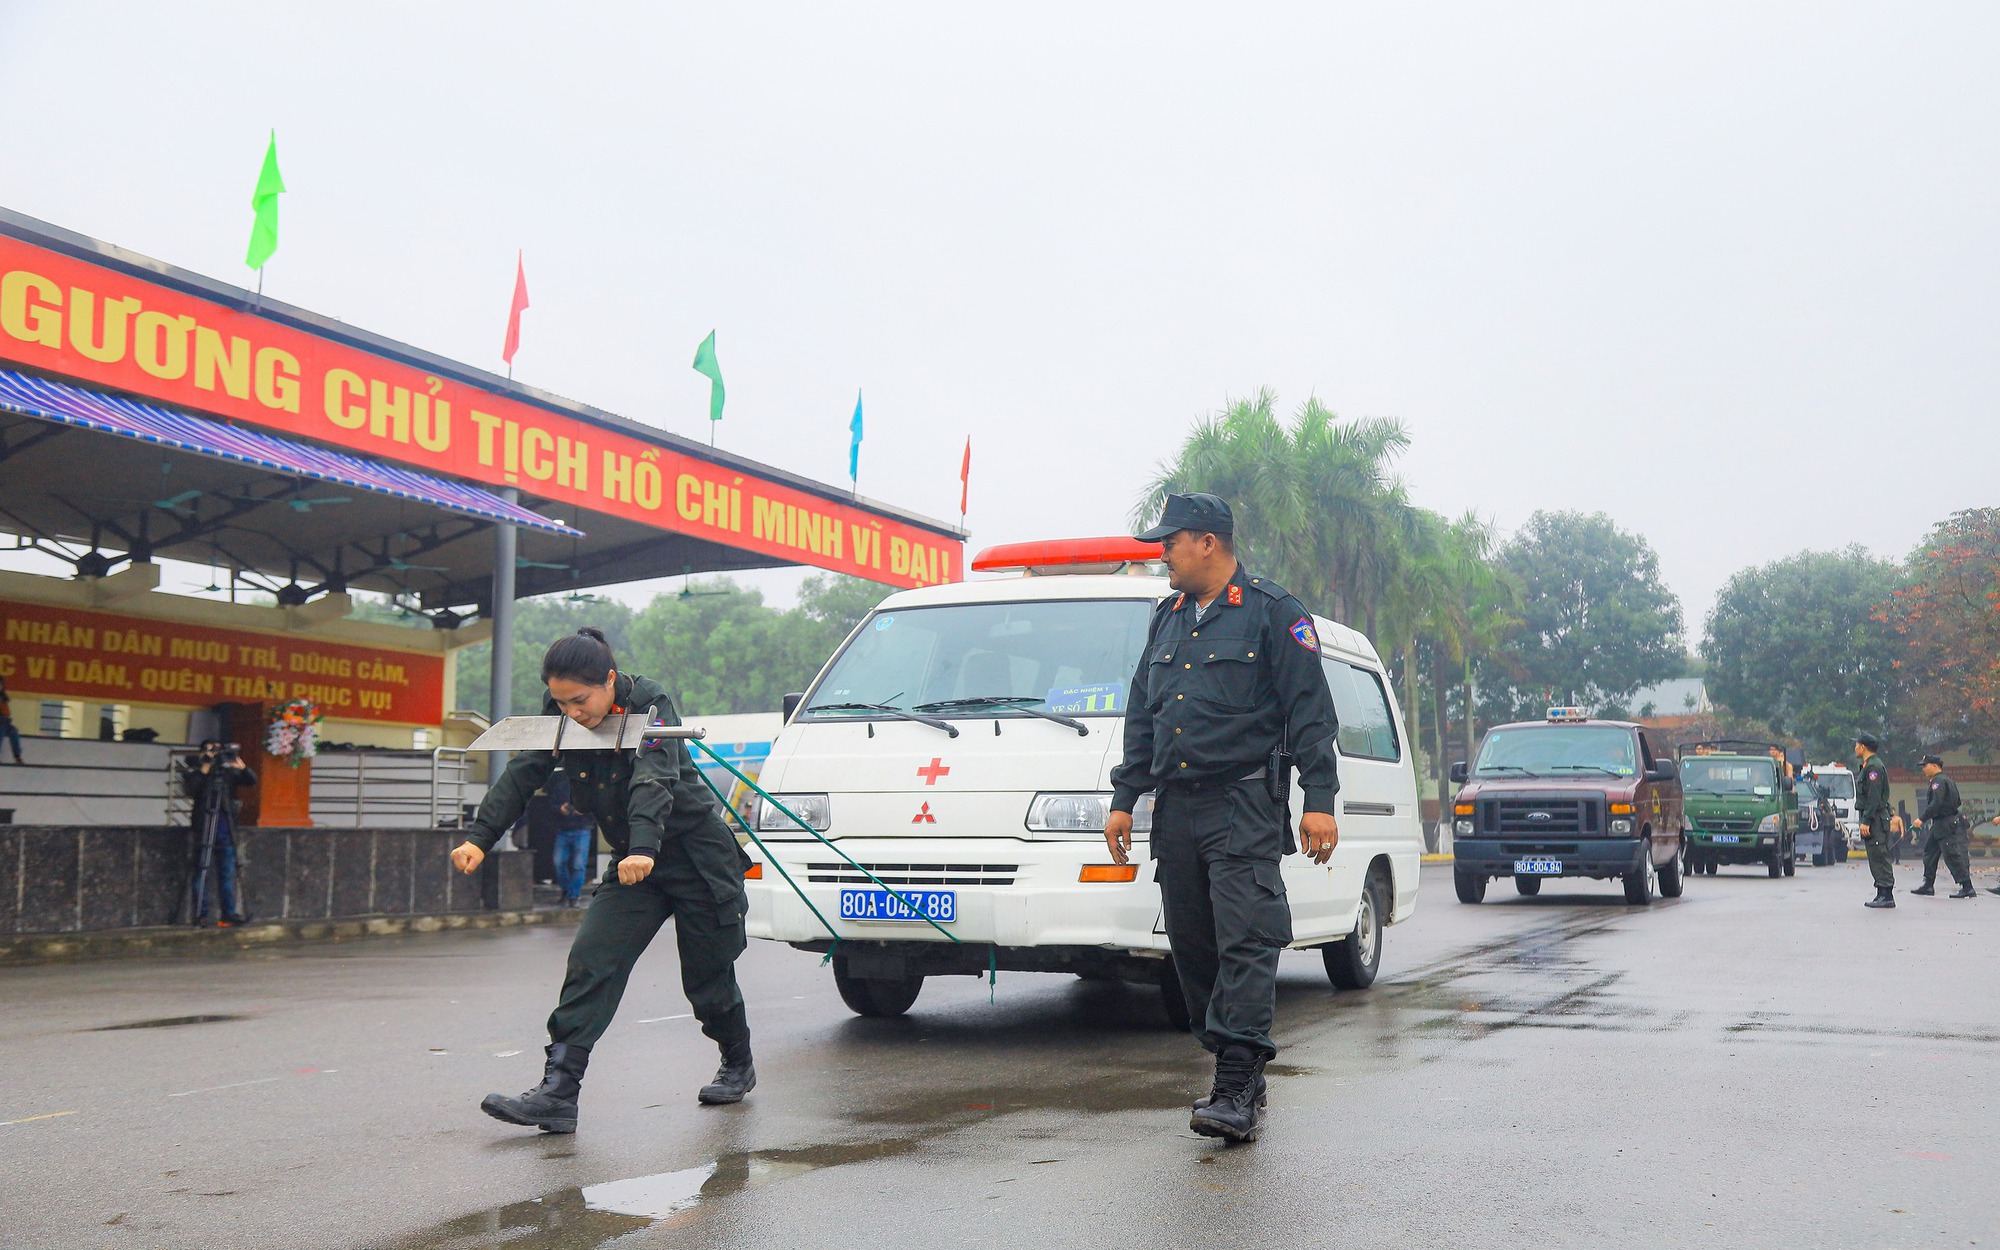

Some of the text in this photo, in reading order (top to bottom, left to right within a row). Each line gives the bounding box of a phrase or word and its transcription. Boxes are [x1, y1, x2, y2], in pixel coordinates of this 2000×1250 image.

[1, 271, 301, 413] GƯƠNG
[324, 369, 451, 453] CHỦ
[471, 410, 588, 491] TỊCH
[603, 448, 662, 510] HỒ
[676, 474, 741, 533] CHÍ
[753, 496, 843, 560] MINH
[851, 520, 881, 569] VĨ
[6, 619, 94, 649] NHÂN
[103, 629, 162, 656] DÂN
[171, 638, 230, 663] MƯU
[290, 652, 352, 678] DŨNG
[357, 658, 409, 686] CẢM,
[27, 655, 56, 680] VÌ
[65, 659, 133, 689] DÂN,
[140, 668, 214, 694] QUÊN
[222, 675, 286, 700] THÂN
[292, 683, 352, 710] PHỤC
[359, 690, 392, 715] VỤ!
[1084, 692, 1117, 712] 11
